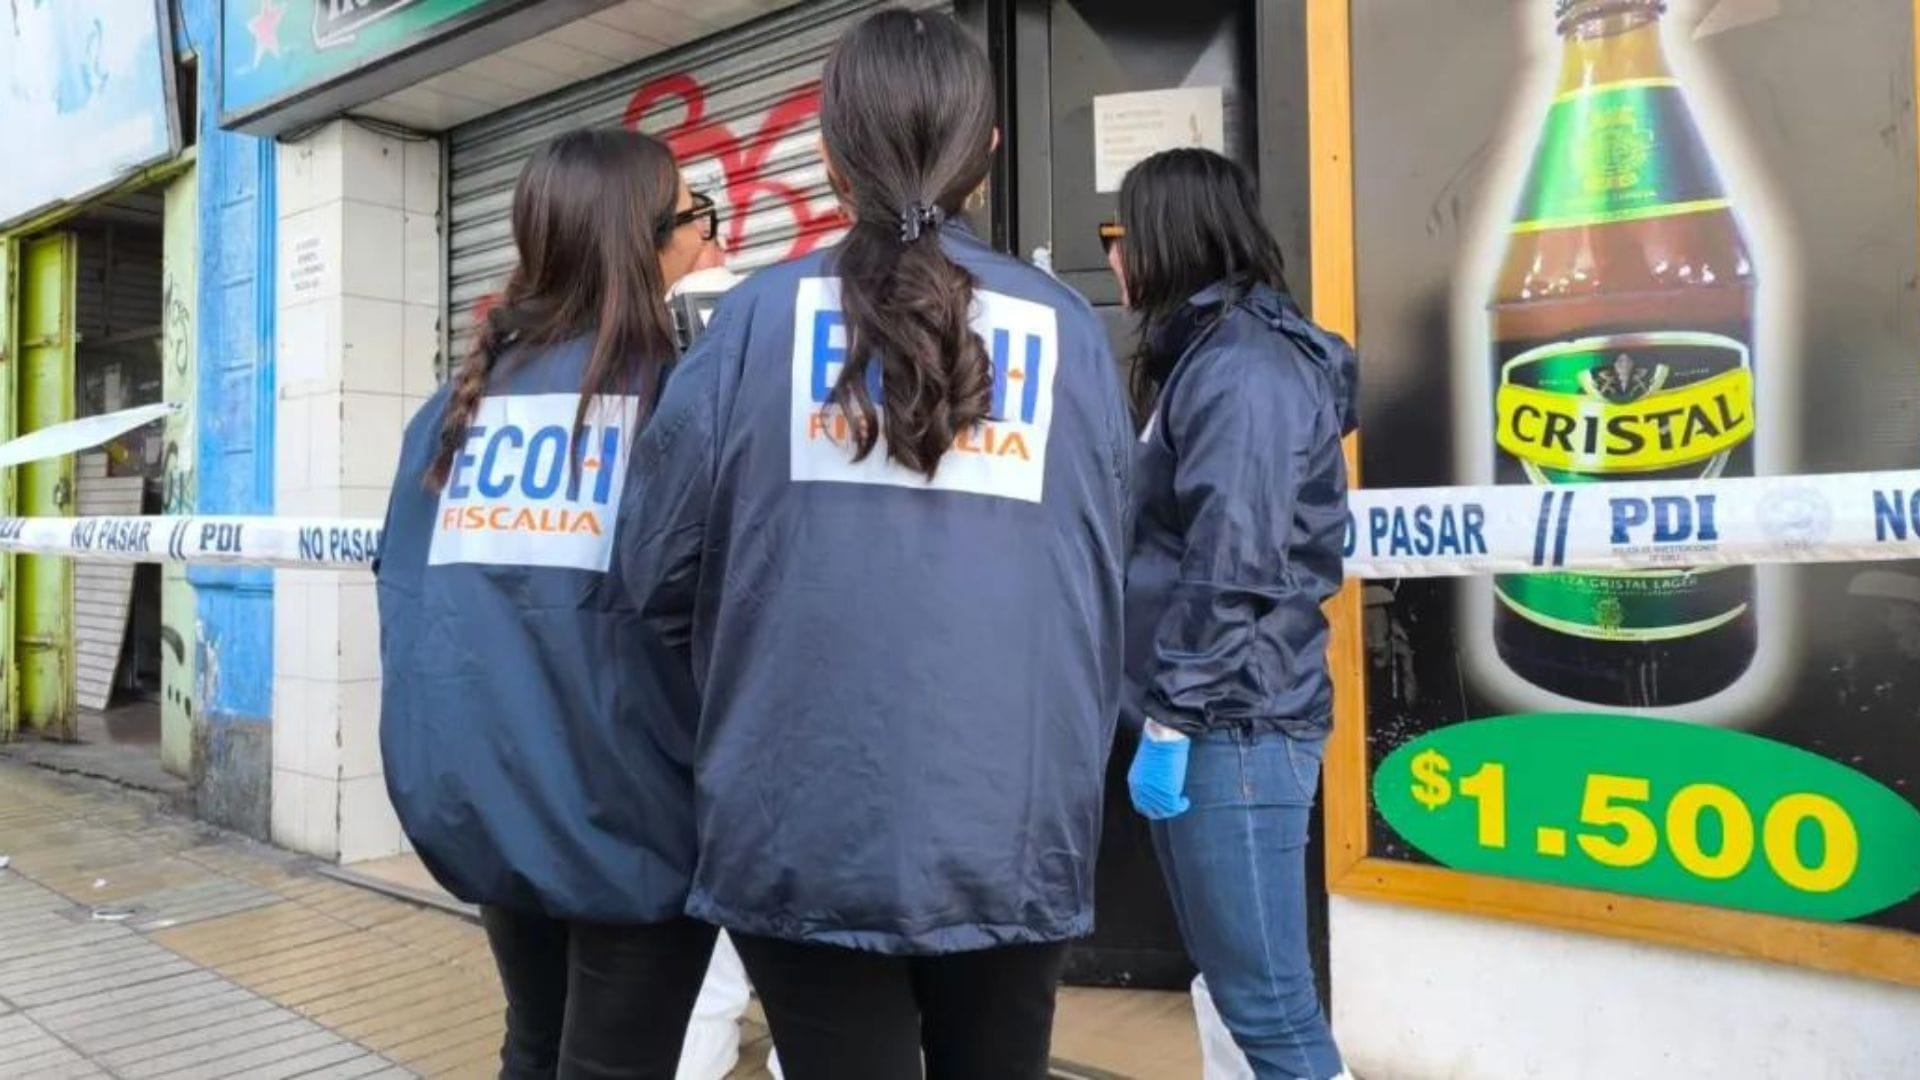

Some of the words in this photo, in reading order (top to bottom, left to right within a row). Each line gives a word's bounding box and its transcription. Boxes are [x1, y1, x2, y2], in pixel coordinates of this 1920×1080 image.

[1511, 393, 1745, 456] CRISTAL
[448, 424, 619, 504] ECOH
[71, 520, 96, 548] NO
[98, 519, 152, 551] PASAR
[199, 522, 244, 552] PDI
[299, 525, 324, 560] NO
[442, 505, 602, 536] FISCALIA
[1369, 503, 1487, 556] PASAR
[1608, 494, 1718, 544] PDI
[1590, 577, 1647, 590] CRISTAL
[1410, 748, 1859, 893] $1.500
